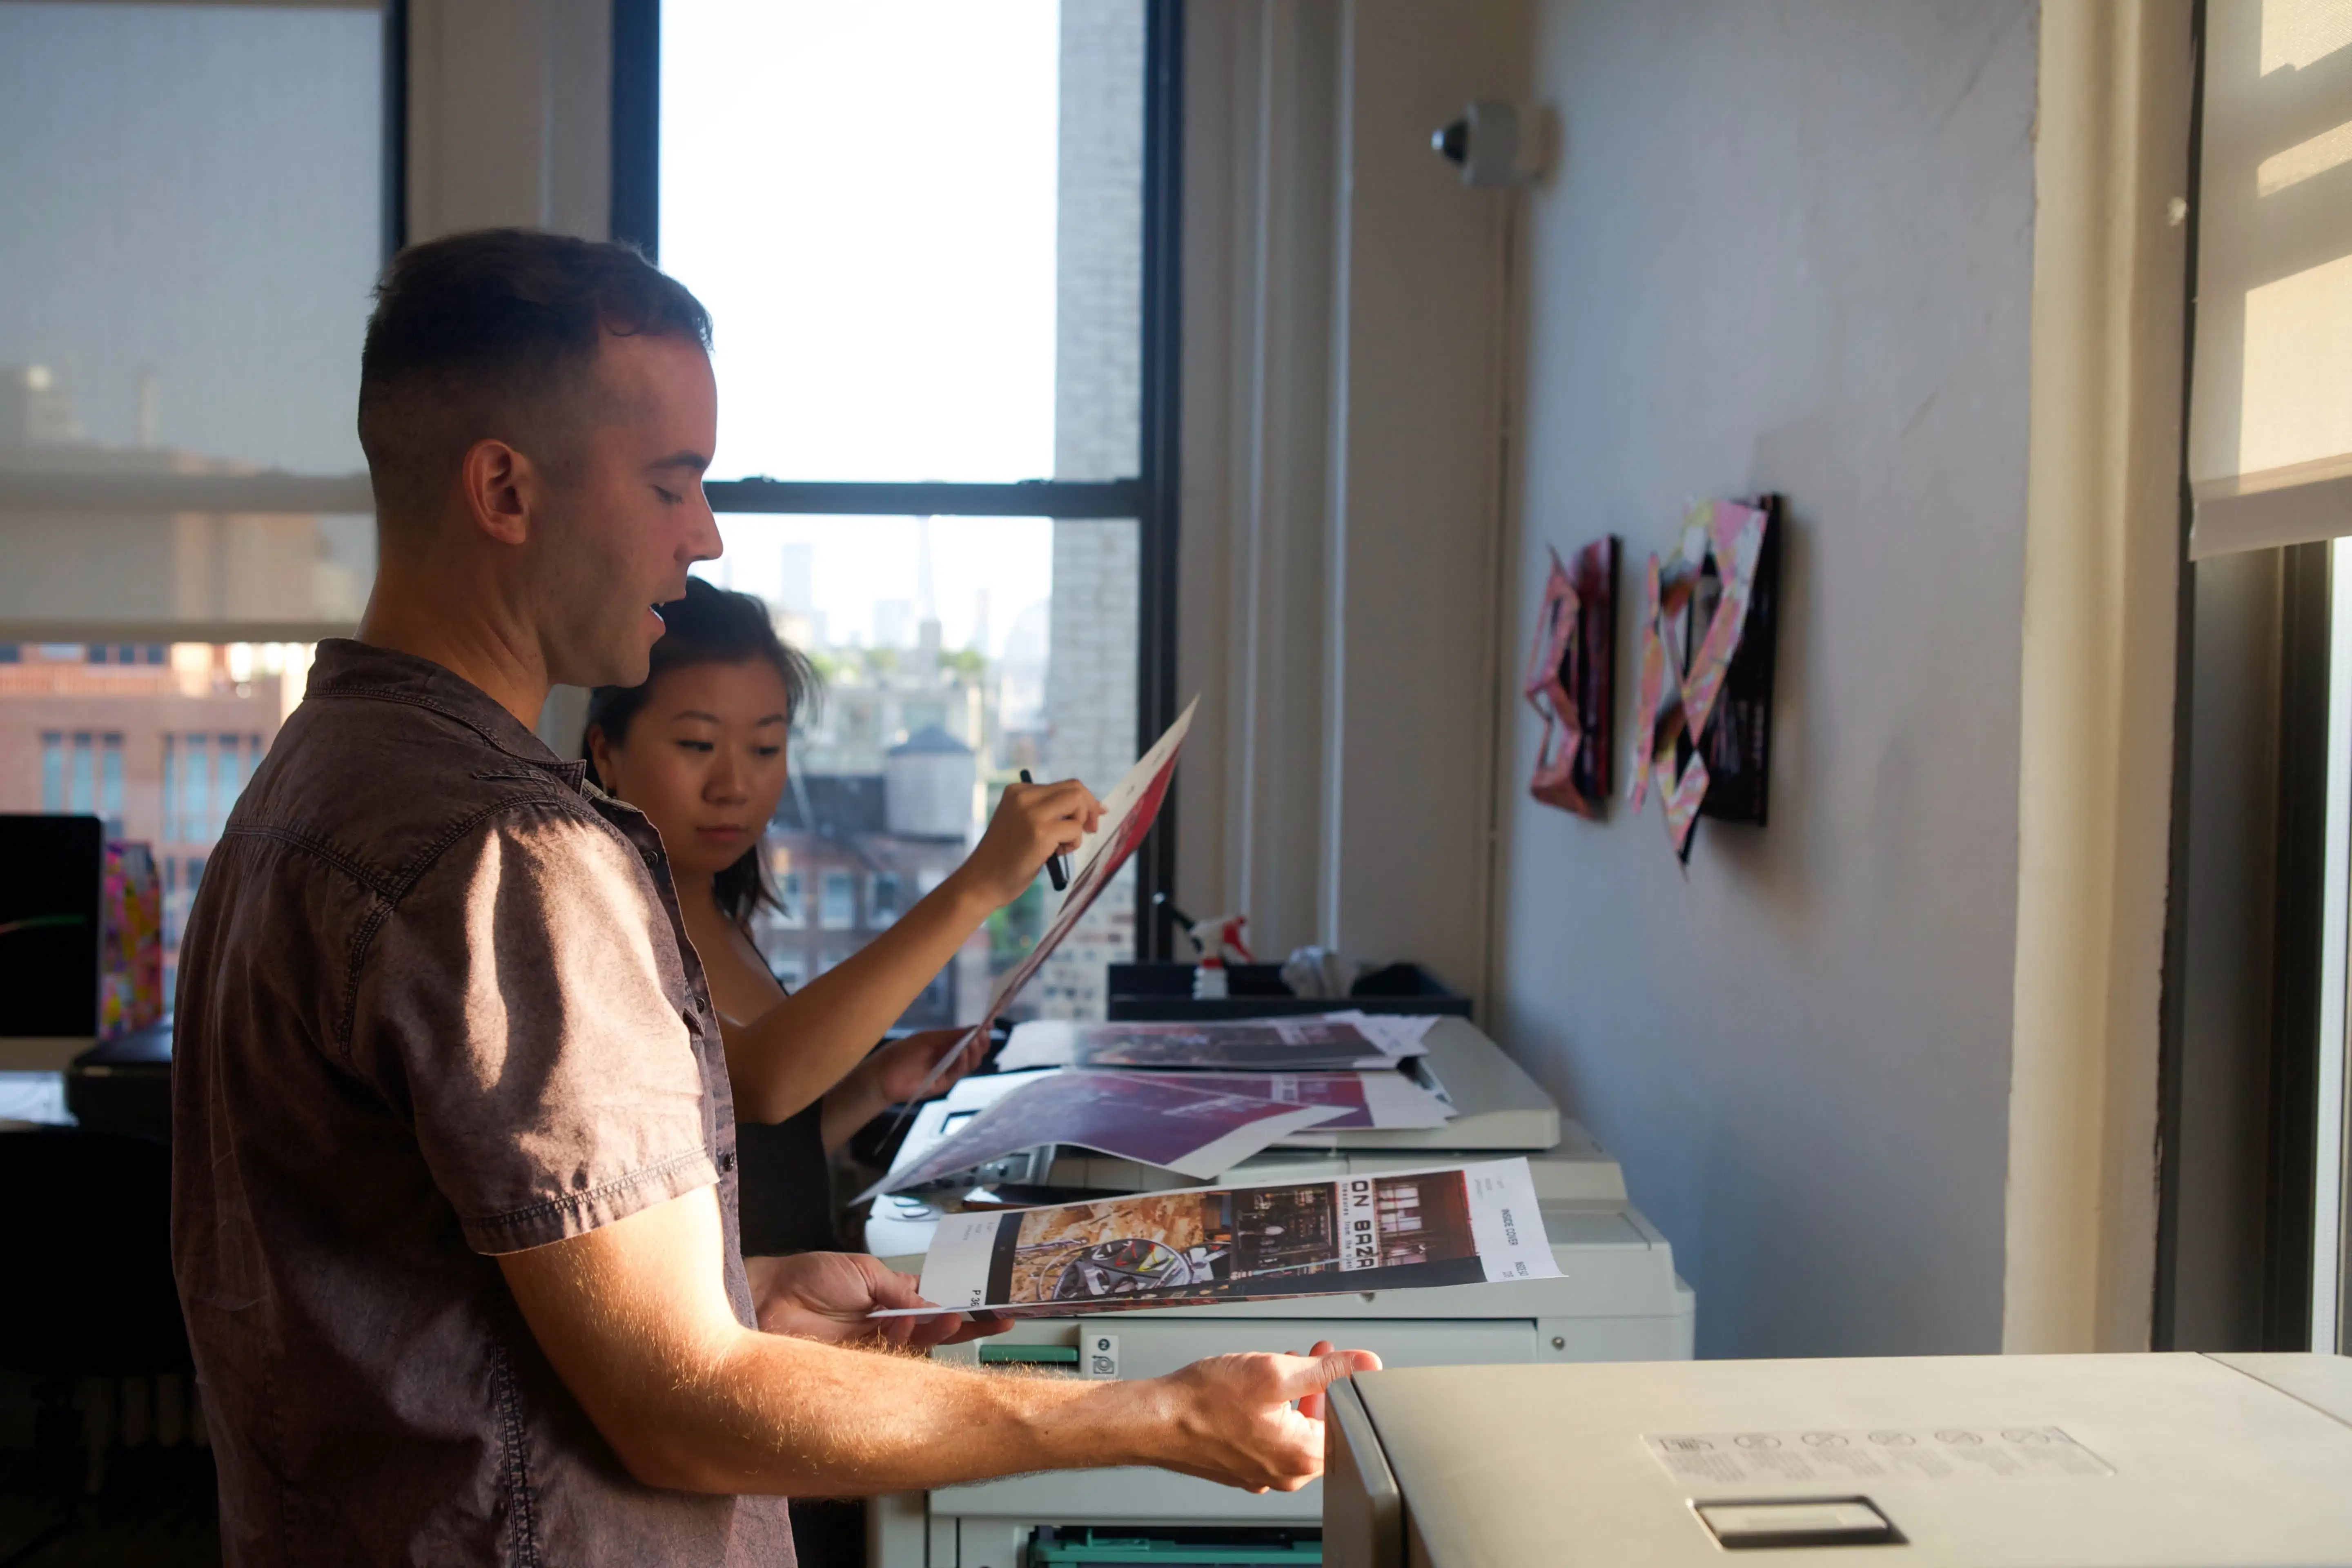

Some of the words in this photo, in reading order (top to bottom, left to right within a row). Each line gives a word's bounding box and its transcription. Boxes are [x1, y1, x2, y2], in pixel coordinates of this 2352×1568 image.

[1352, 1180, 1370, 1207] ON
[1501, 1208, 1513, 1227] INSIDE
[1506, 1228, 1519, 1245] COVER
